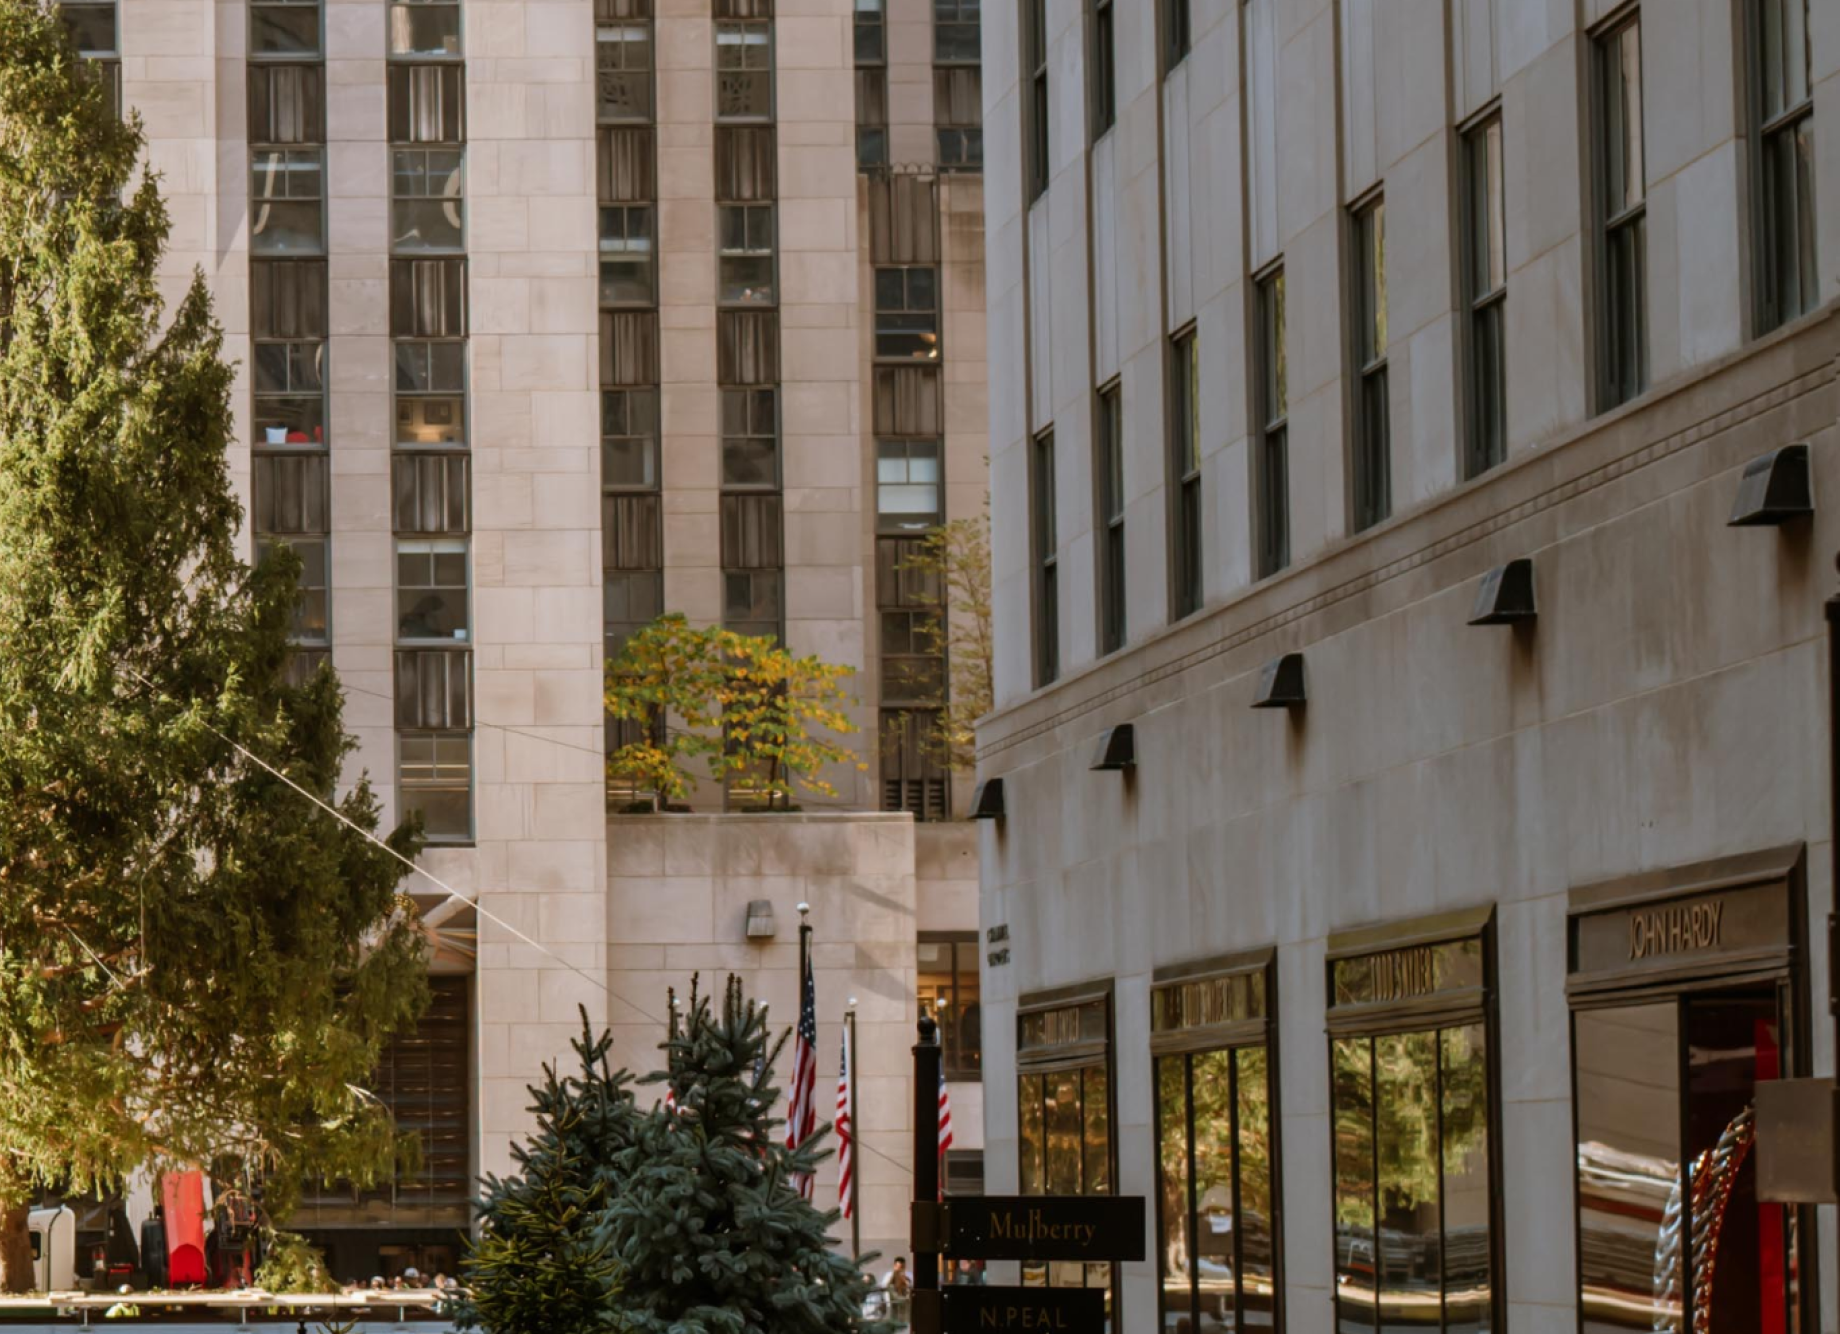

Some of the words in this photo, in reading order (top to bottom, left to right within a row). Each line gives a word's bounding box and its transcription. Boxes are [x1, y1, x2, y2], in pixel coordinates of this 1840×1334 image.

[1628, 910, 1668, 961] JOHN
[1671, 900, 1723, 954] HARDY
[989, 1208, 1096, 1246] Mulberry
[979, 1306, 1068, 1328] N.PEAL
